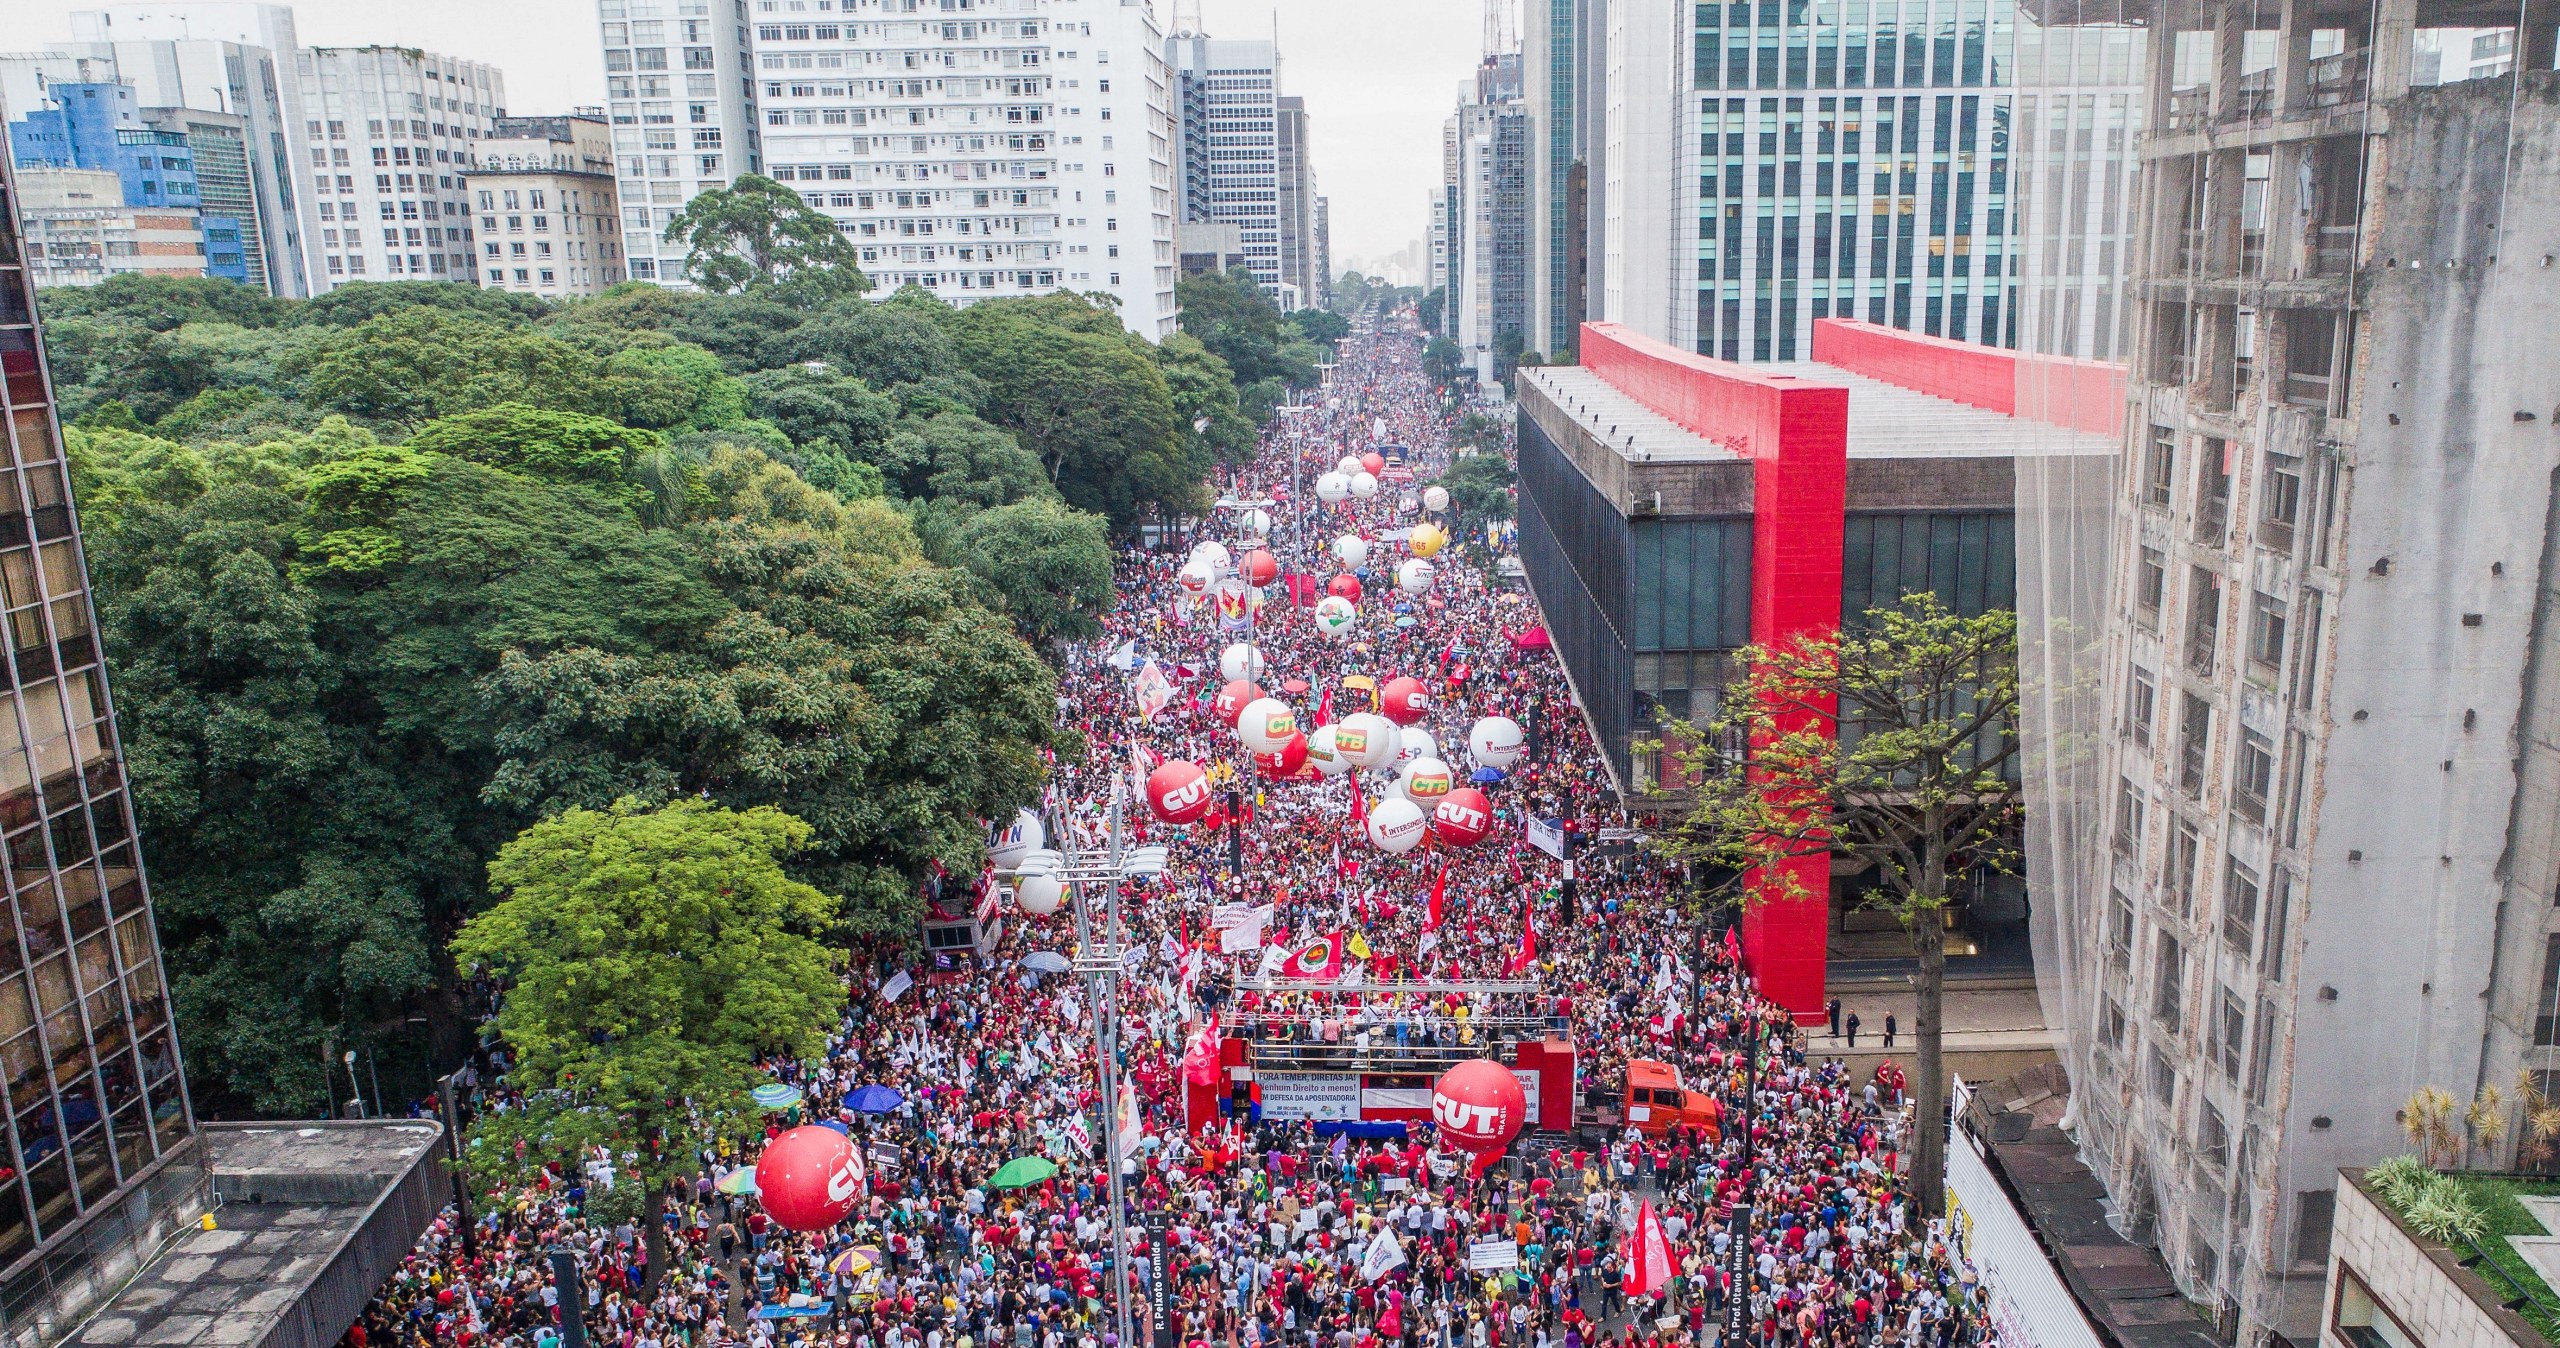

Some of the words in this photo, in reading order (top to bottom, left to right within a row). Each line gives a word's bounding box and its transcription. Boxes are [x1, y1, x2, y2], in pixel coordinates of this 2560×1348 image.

[1163, 775, 1209, 811] CUT
[1411, 777, 1449, 793] CTB
[1437, 802, 1484, 828] CUT
[1260, 1073, 1279, 1081] FORA
[1281, 1073, 1310, 1082] TEMER,
[1312, 1073, 1344, 1081] DIRETAS
[1260, 1083, 1291, 1092] Nenhum
[1293, 1083, 1319, 1092] Direito
[1328, 1083, 1356, 1092] menos!
[1433, 1092, 1499, 1134] CUT
[1498, 1105, 1507, 1135] BRASIL
[1459, 1131, 1497, 1140] TRABALHADORES
[1151, 1241, 1161, 1279] Gomide
[1733, 1233, 1743, 1271] Mendes
[1154, 1281, 1164, 1319] Peixoto
[1732, 1273, 1742, 1304] Otavio
[1155, 1320, 1164, 1330] R.
[1732, 1306, 1741, 1328] Prof.
[1731, 1331, 1740, 1340] R.
